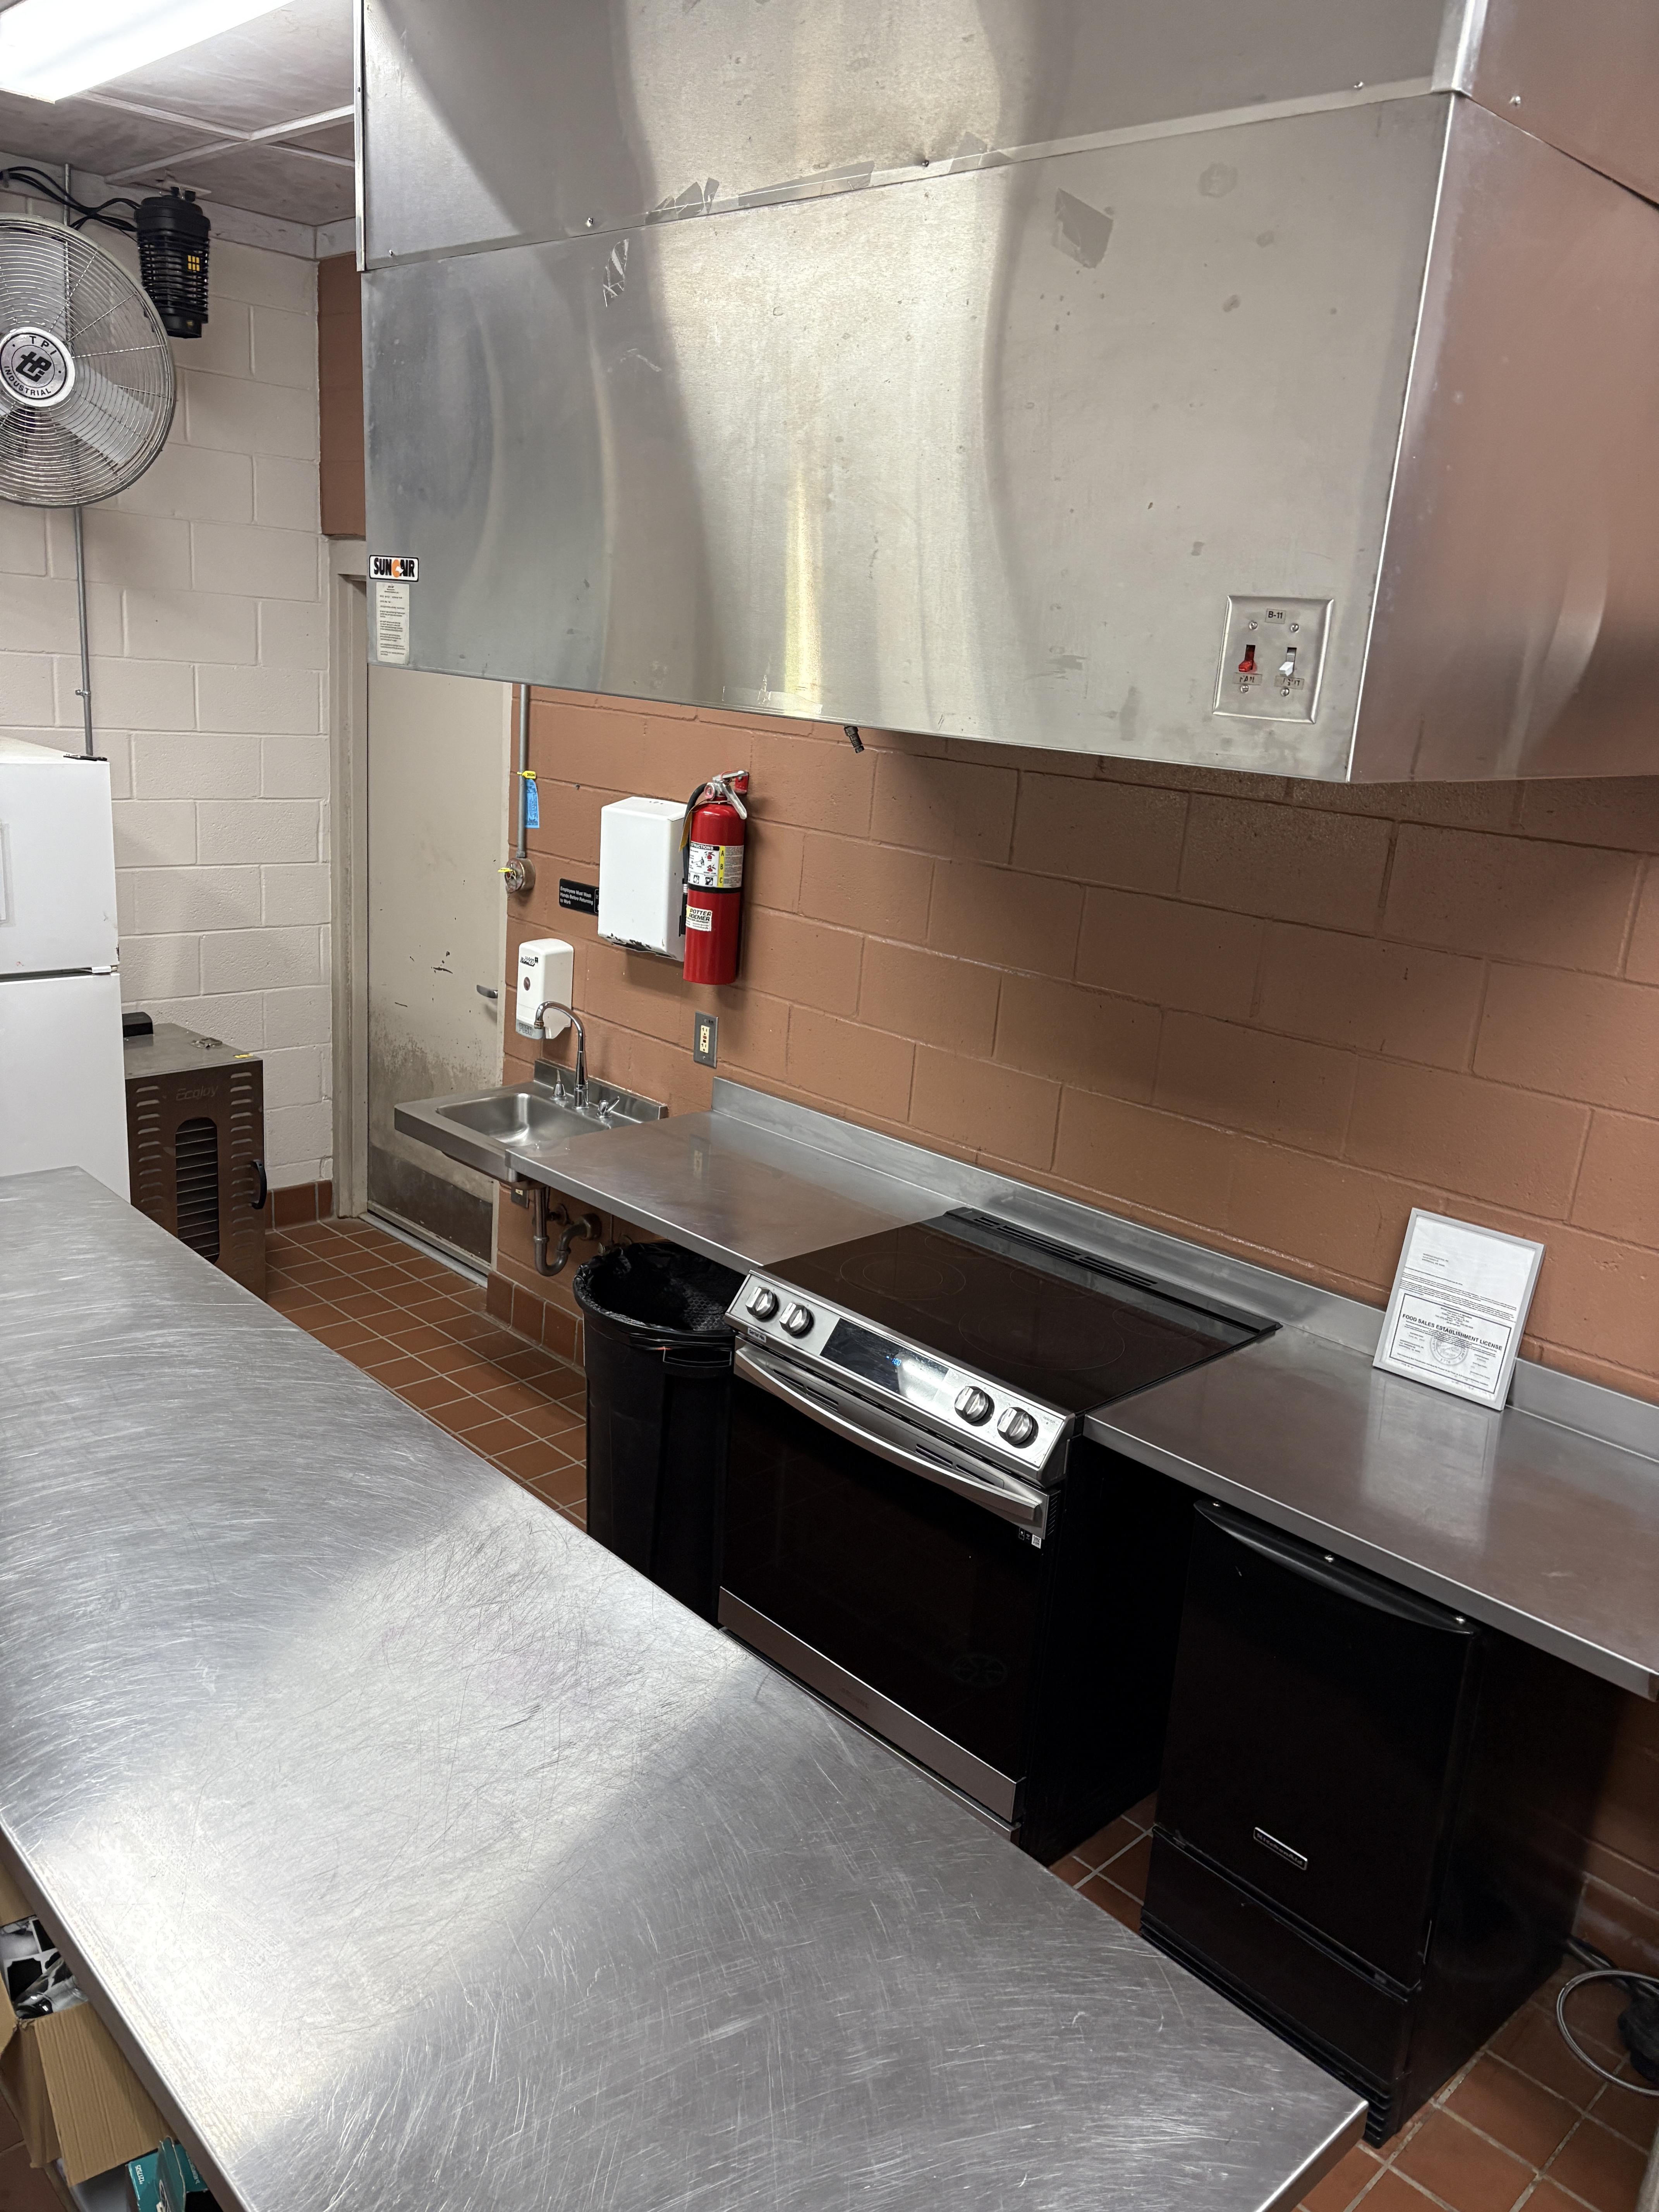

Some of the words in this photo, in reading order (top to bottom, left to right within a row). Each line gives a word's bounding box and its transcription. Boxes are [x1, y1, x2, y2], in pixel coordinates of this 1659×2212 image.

[29, 335, 57, 355] TPI
[4, 366, 52, 396] INDUSTRIAL
[560, 886, 575, 894] Employees
[579, 897, 593, 905] Returning
[690, 908, 711, 916] POTTER
[519, 1022, 532, 1036] PUSH
[749, 1329, 759, 1338] Serial
[1402, 1313, 1417, 1322] FOOD
[1418, 1319, 1434, 1328] SALES
[1436, 1324, 1479, 1343] ESTABLISHMENT
[1480, 1339, 1503, 1350] LICENSE
[1257, 1832, 1303, 1865] KitchenAid
